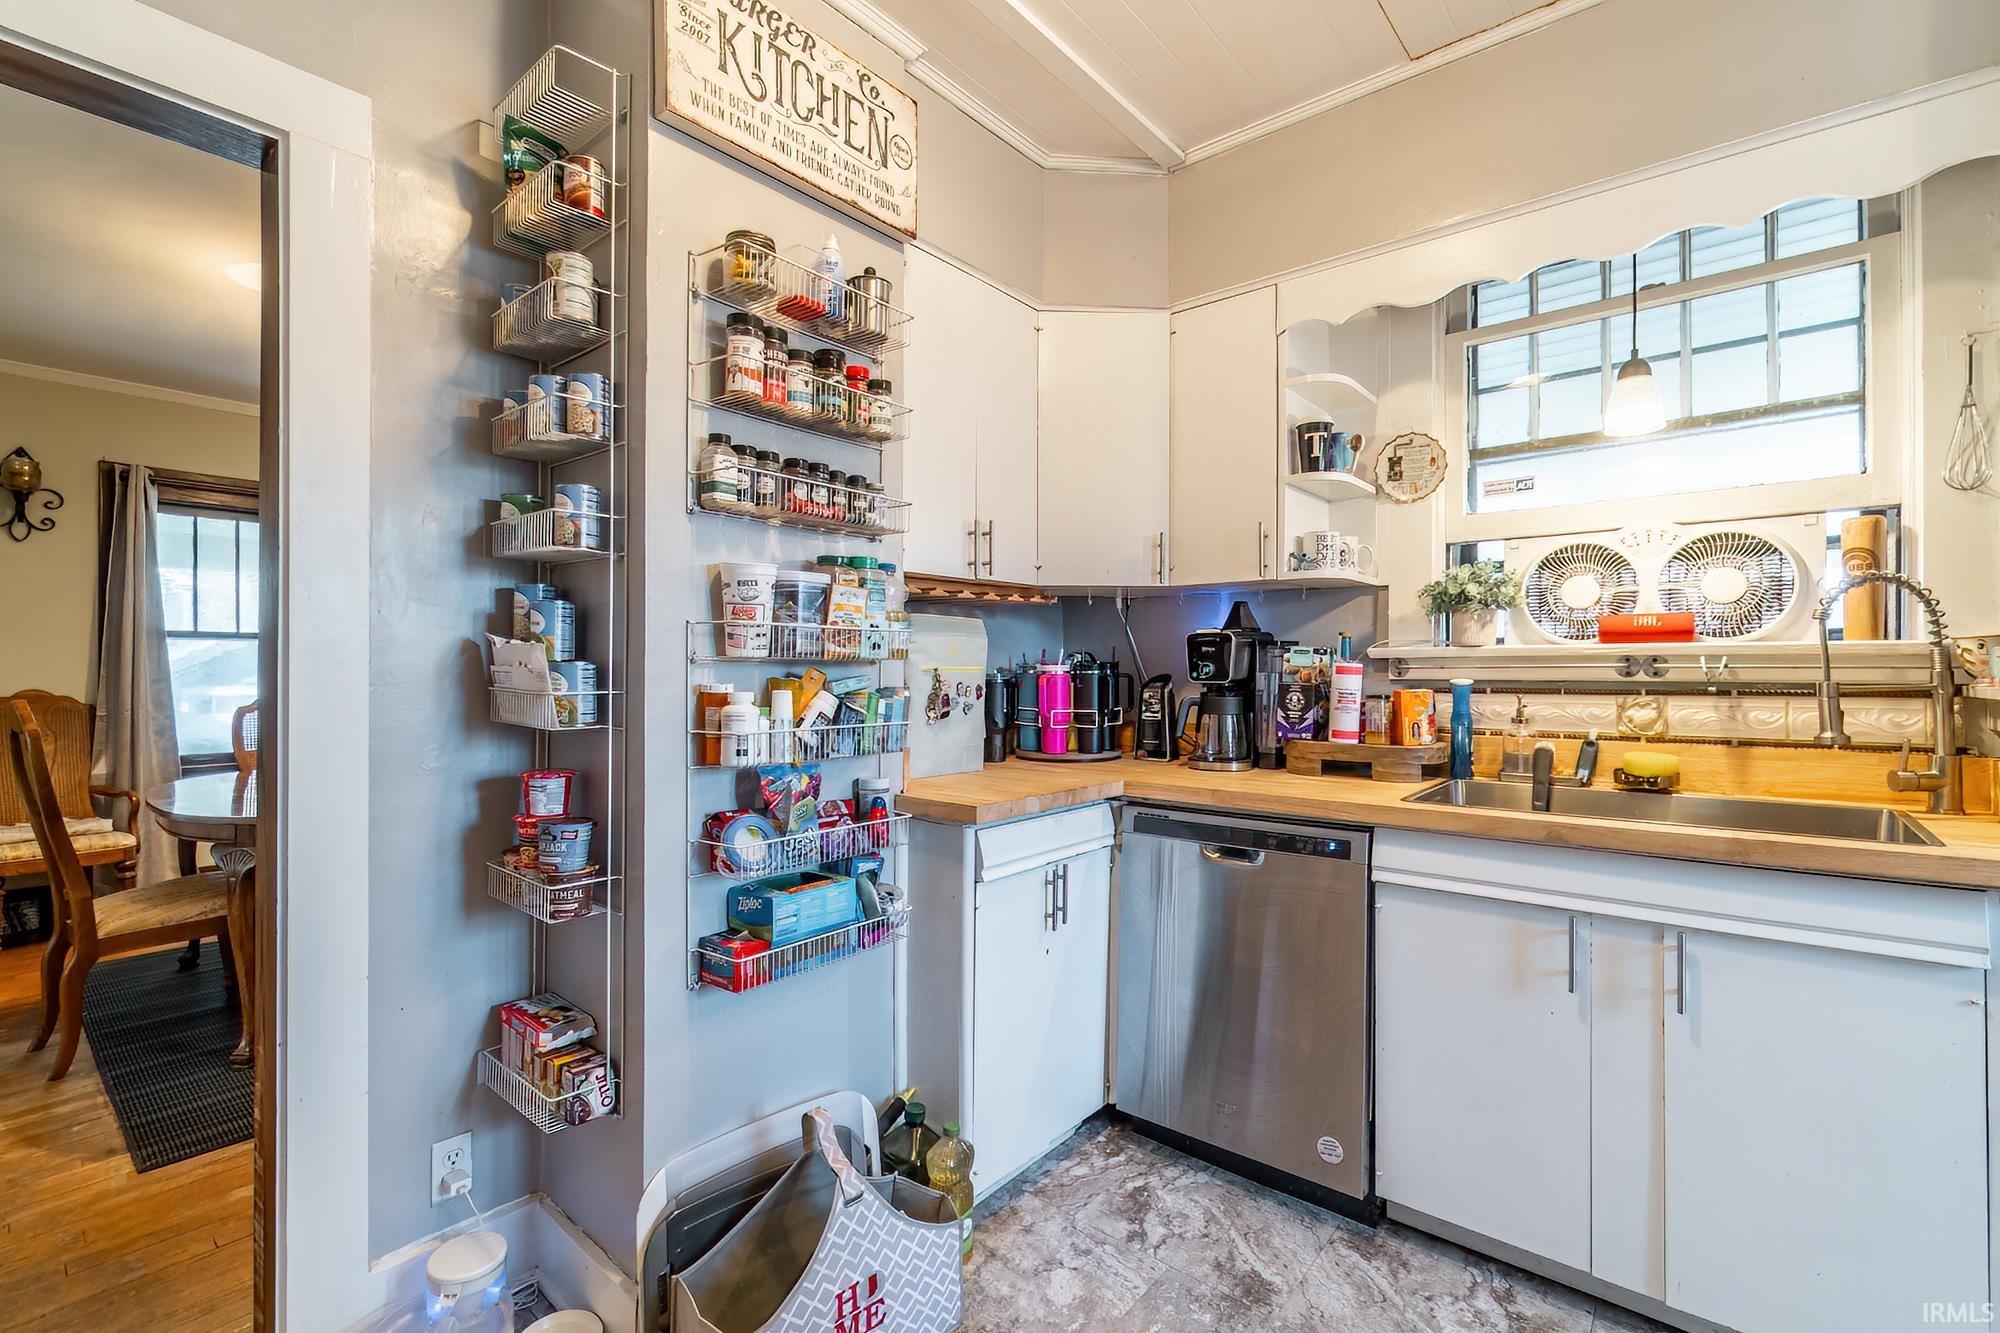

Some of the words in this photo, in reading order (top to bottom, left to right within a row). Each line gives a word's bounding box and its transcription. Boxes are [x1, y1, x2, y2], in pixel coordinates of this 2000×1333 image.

[681, 20, 711, 43] 2007
[717, 8, 889, 170] KITCHEN
[690, 89, 725, 121] WHEN
[730, 112, 767, 143] FAMILY
[772, 136, 792, 158] AND
[795, 148, 833, 181] FRIENDS
[837, 174, 871, 201] GATHER
[873, 192, 901, 217] ROUND
[702, 77, 724, 102] THE
[729, 93, 756, 119] BEST
[760, 111, 773, 128] OF
[775, 119, 807, 147] TIMES
[810, 140, 828, 162] ARE
[832, 153, 868, 182] ALWAYS
[869, 173, 896, 198] FOUND
[1304, 431, 1328, 458] T
[737, 896, 763, 913] Ziploc
